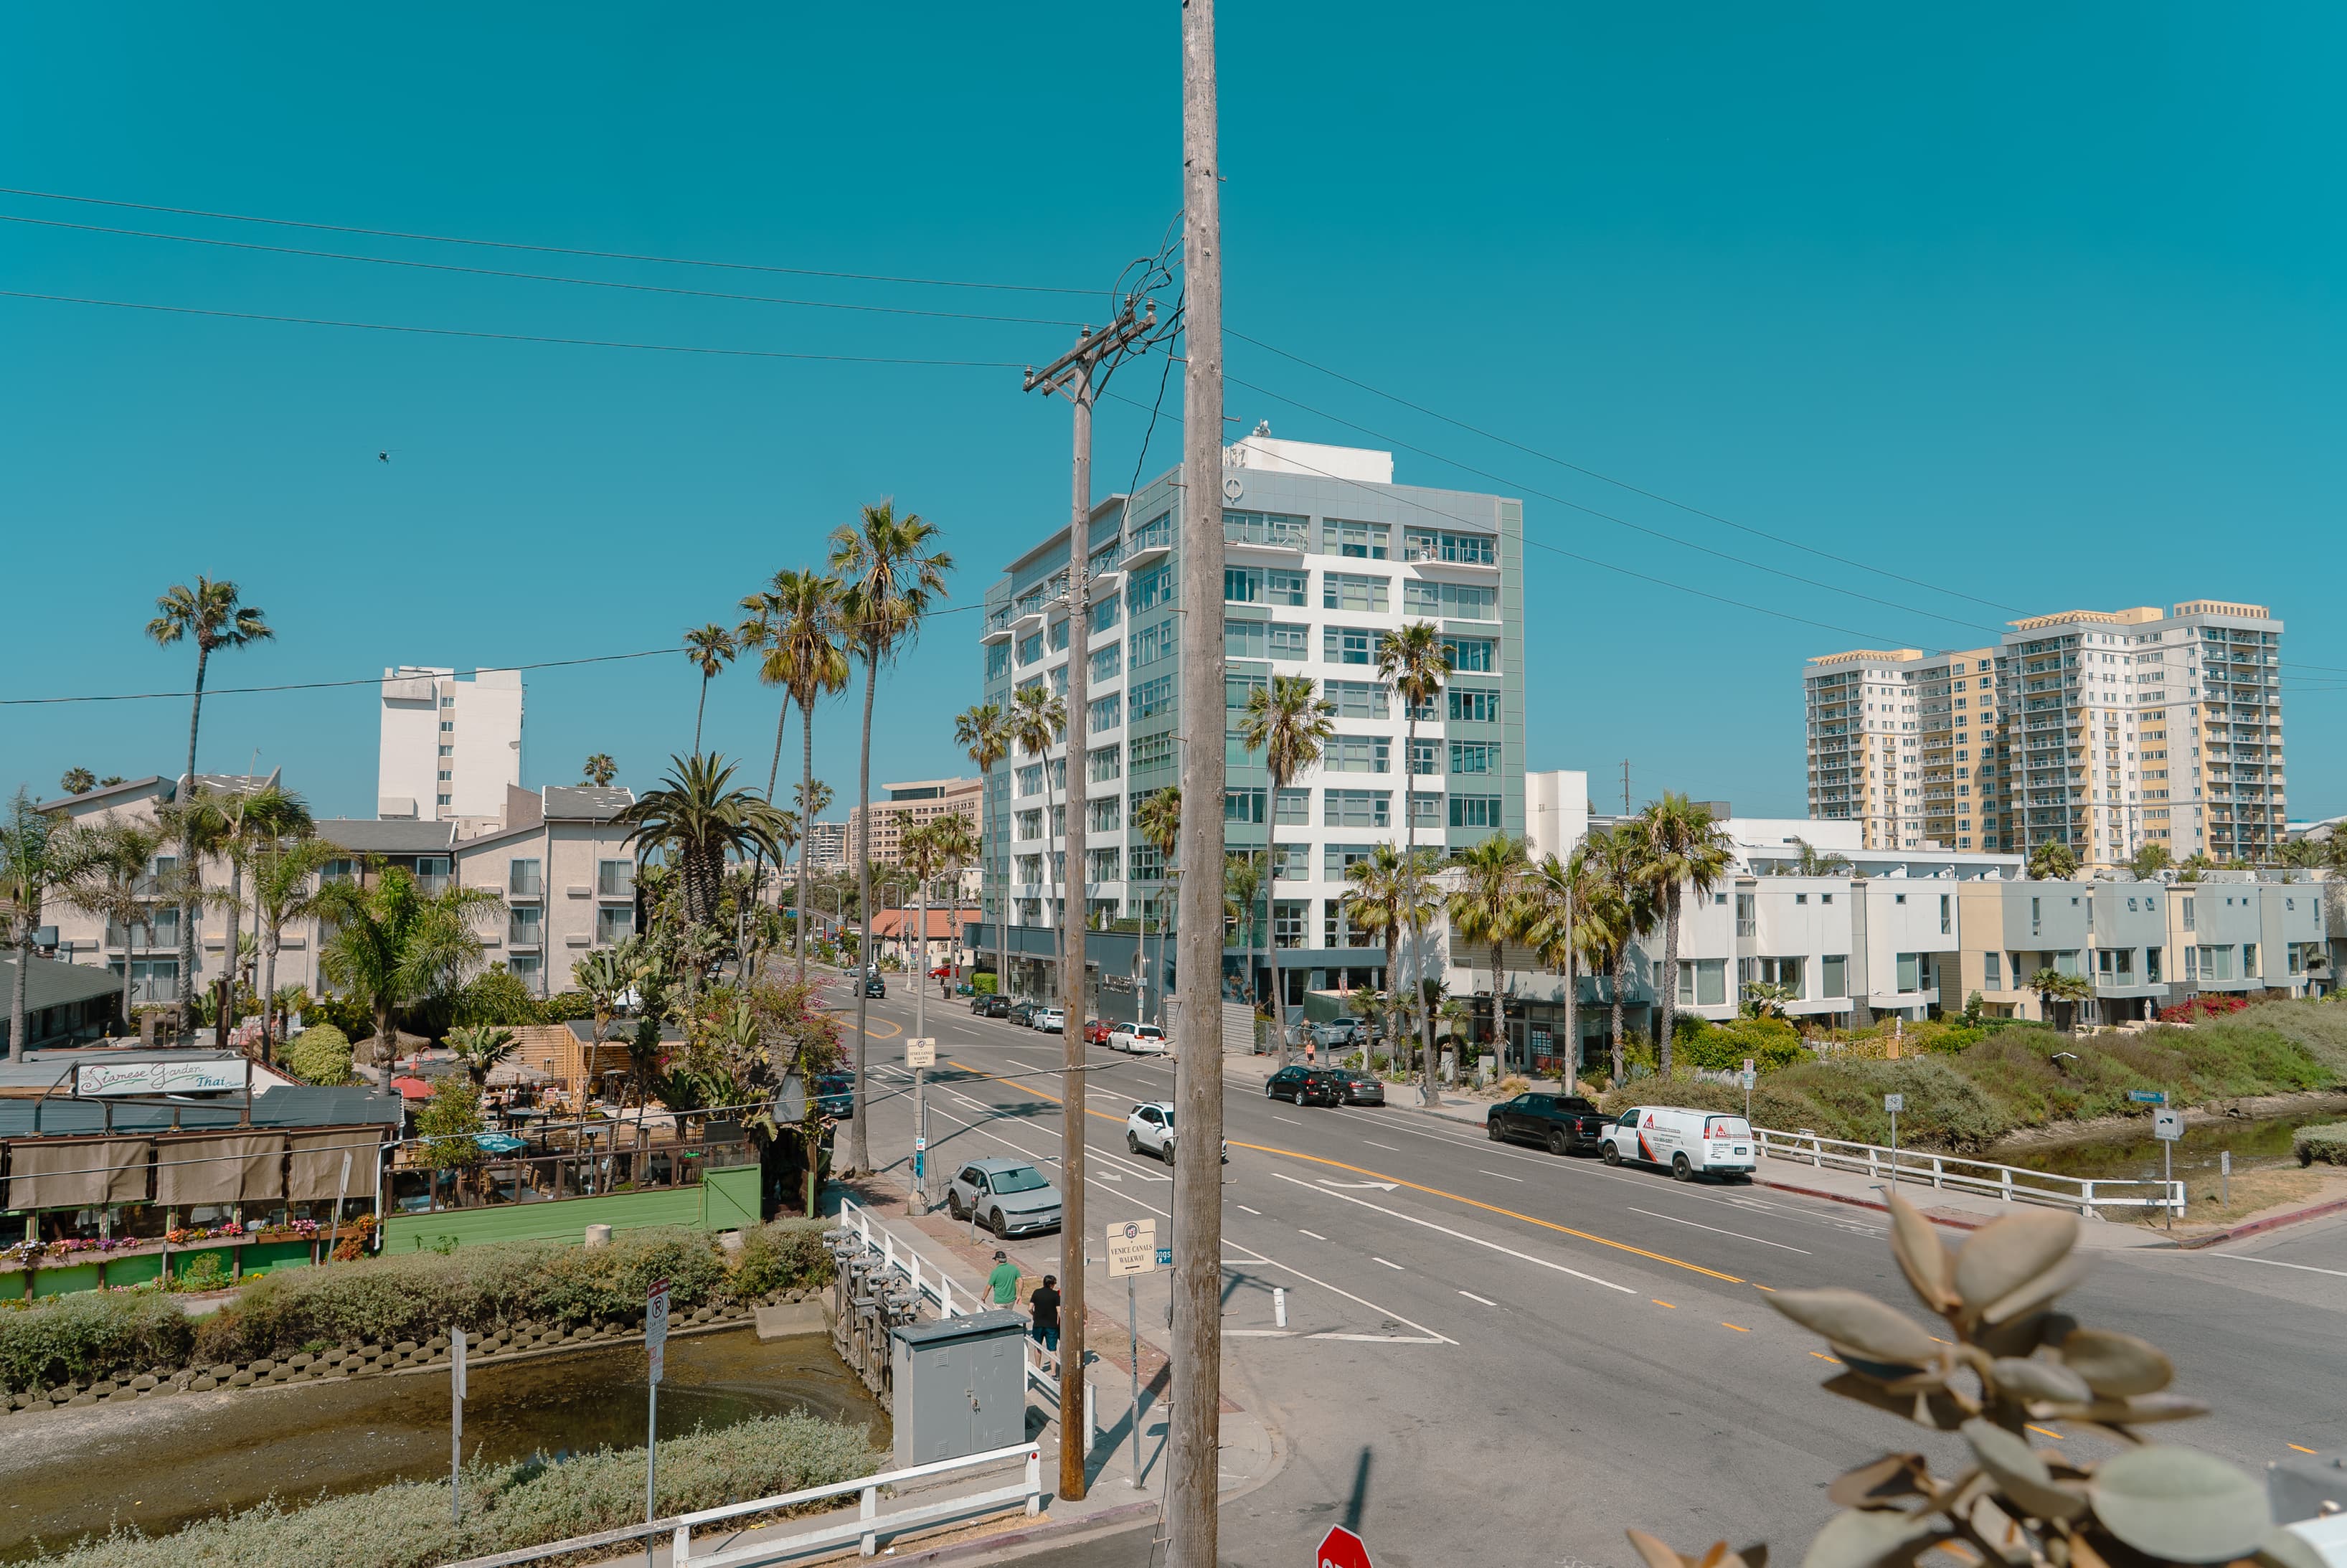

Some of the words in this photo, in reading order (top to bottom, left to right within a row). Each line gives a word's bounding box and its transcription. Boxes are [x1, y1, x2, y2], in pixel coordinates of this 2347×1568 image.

[1606, 990, 1640, 1002] BACH
[81, 1065, 148, 1093] Siamese
[150, 1062, 205, 1090] Garden
[195, 1075, 225, 1087] Thai
[1111, 1247, 1130, 1255] VENICE
[1132, 1244, 1153, 1252] CANALS
[1119, 1255, 1145, 1263] WALKWAY
